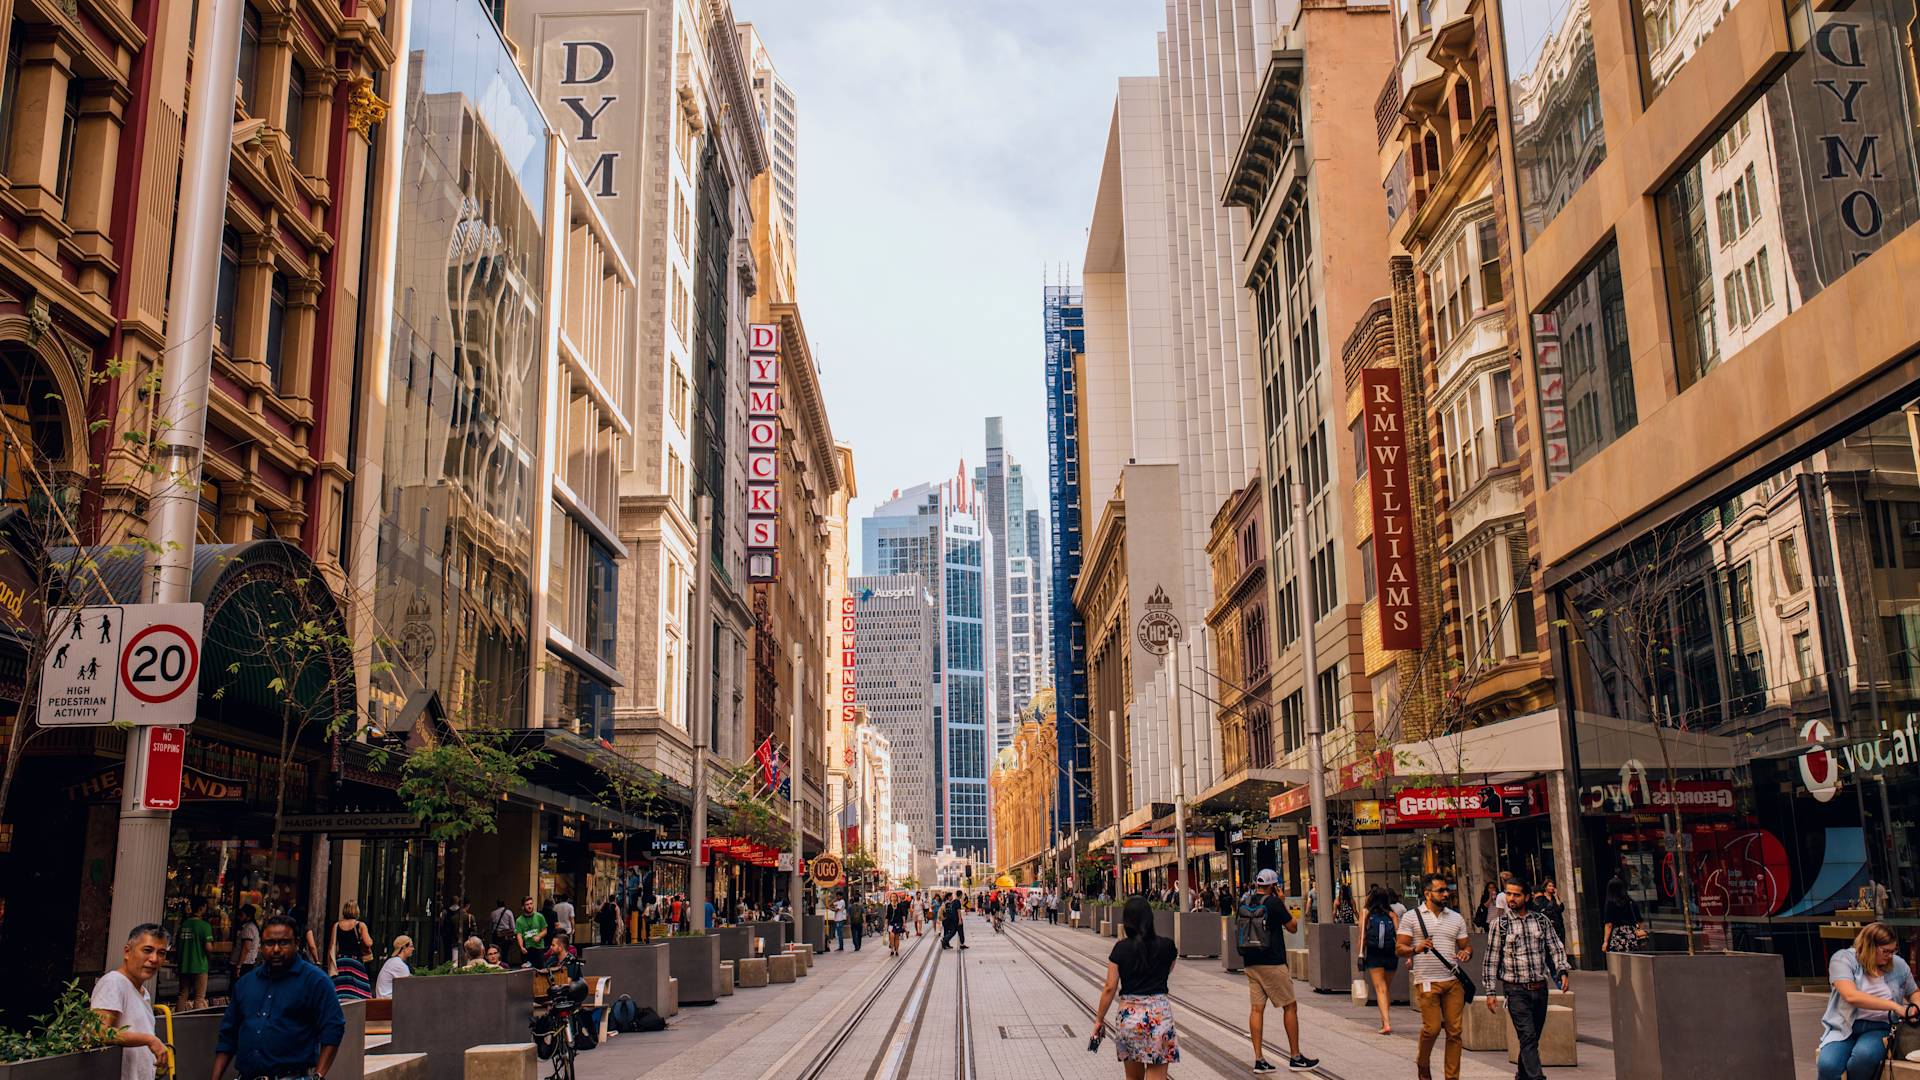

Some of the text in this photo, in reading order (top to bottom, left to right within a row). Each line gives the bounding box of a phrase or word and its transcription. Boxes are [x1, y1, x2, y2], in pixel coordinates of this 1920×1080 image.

[750, 327, 774, 544] DYMOCKS
[873, 586, 915, 599] Ausgrid
[1144, 612, 1174, 624] HEALTH
[1139, 633, 1155, 650] CARE
[132, 644, 186, 682] 20
[843, 599, 855, 720] GOWINGS
[66, 686, 90, 695] HIGH
[48, 697, 107, 706] PEDESTRIAN
[54, 708, 98, 717] ACTIVITY
[162, 732, 173, 742] NO
[1842, 712, 1919, 773] vodaf
[152, 742, 180, 753] STOPPING
[61, 769, 118, 801] THE
[181, 771, 228, 798] AND
[285, 815, 416, 827] HAIGH'S CHOCOLATES
[651, 840, 685, 850] HYPE
[817, 861, 836, 877] UGG
